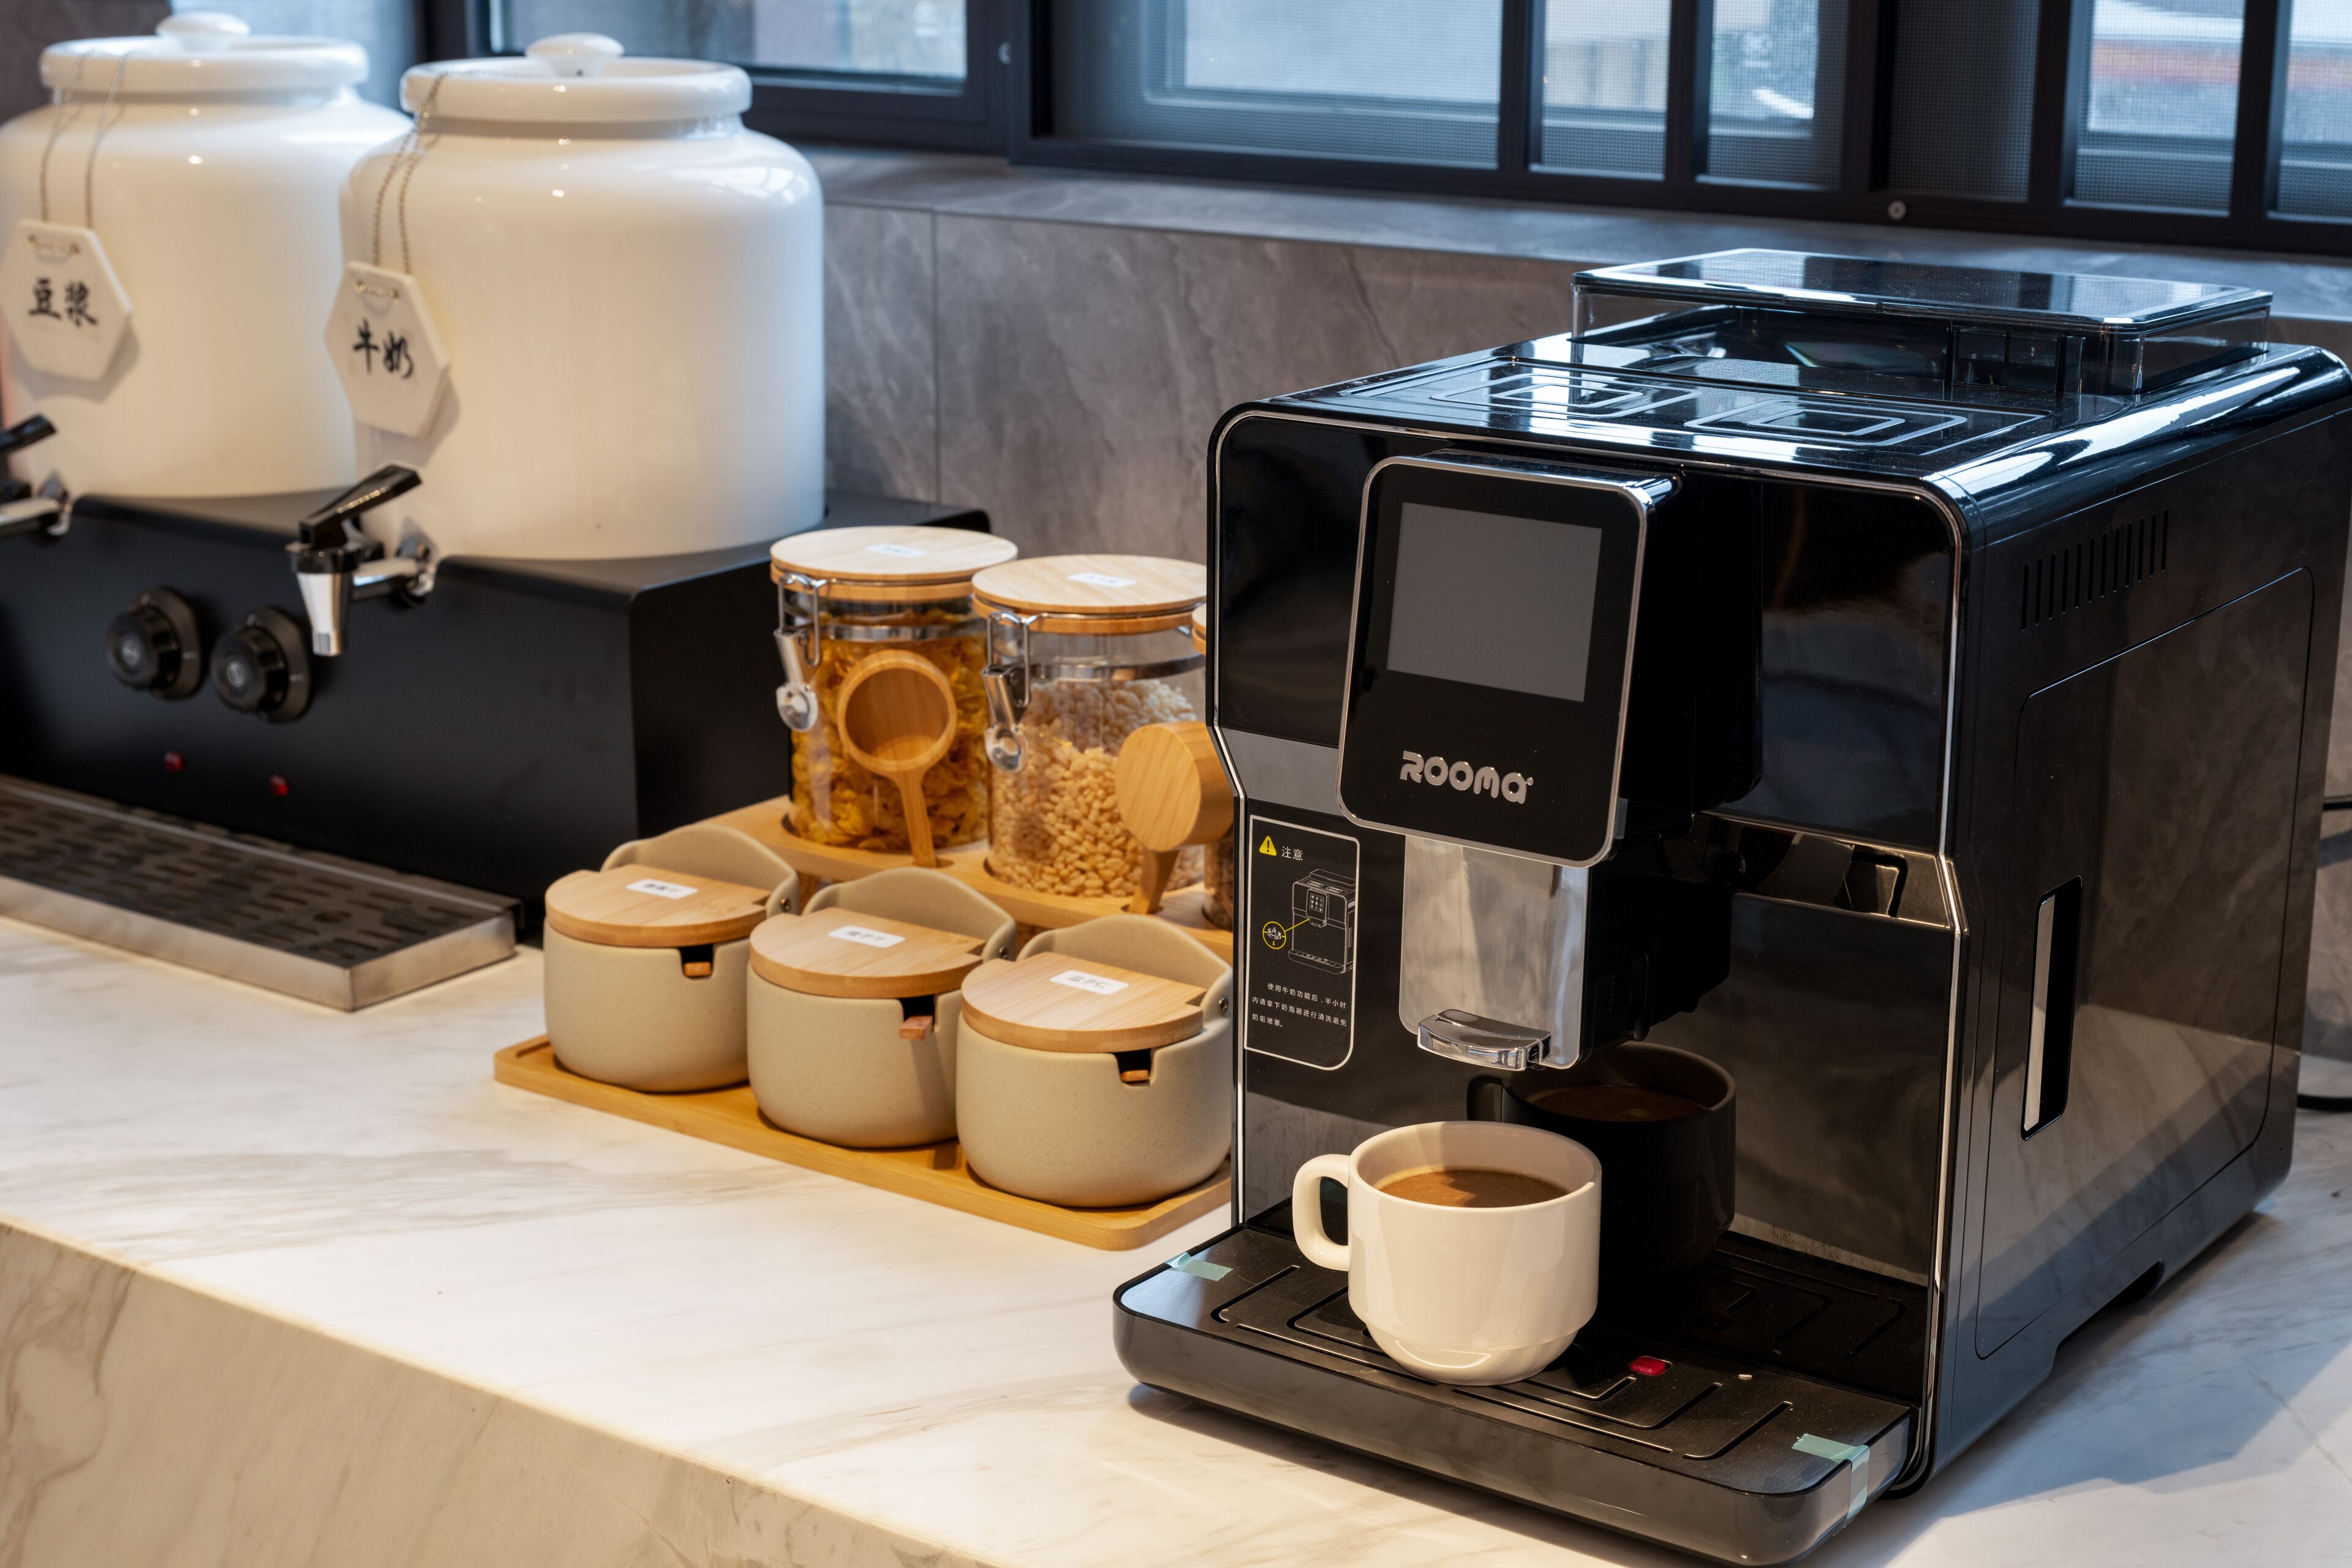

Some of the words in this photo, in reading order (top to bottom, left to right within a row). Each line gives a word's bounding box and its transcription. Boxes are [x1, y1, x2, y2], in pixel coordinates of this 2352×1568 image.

[352, 317, 415, 380] 牛奶
[1281, 846, 1303, 861] 注意
[1252, 996, 1348, 1027] 内请拿下奶泡器进行清洗避免
